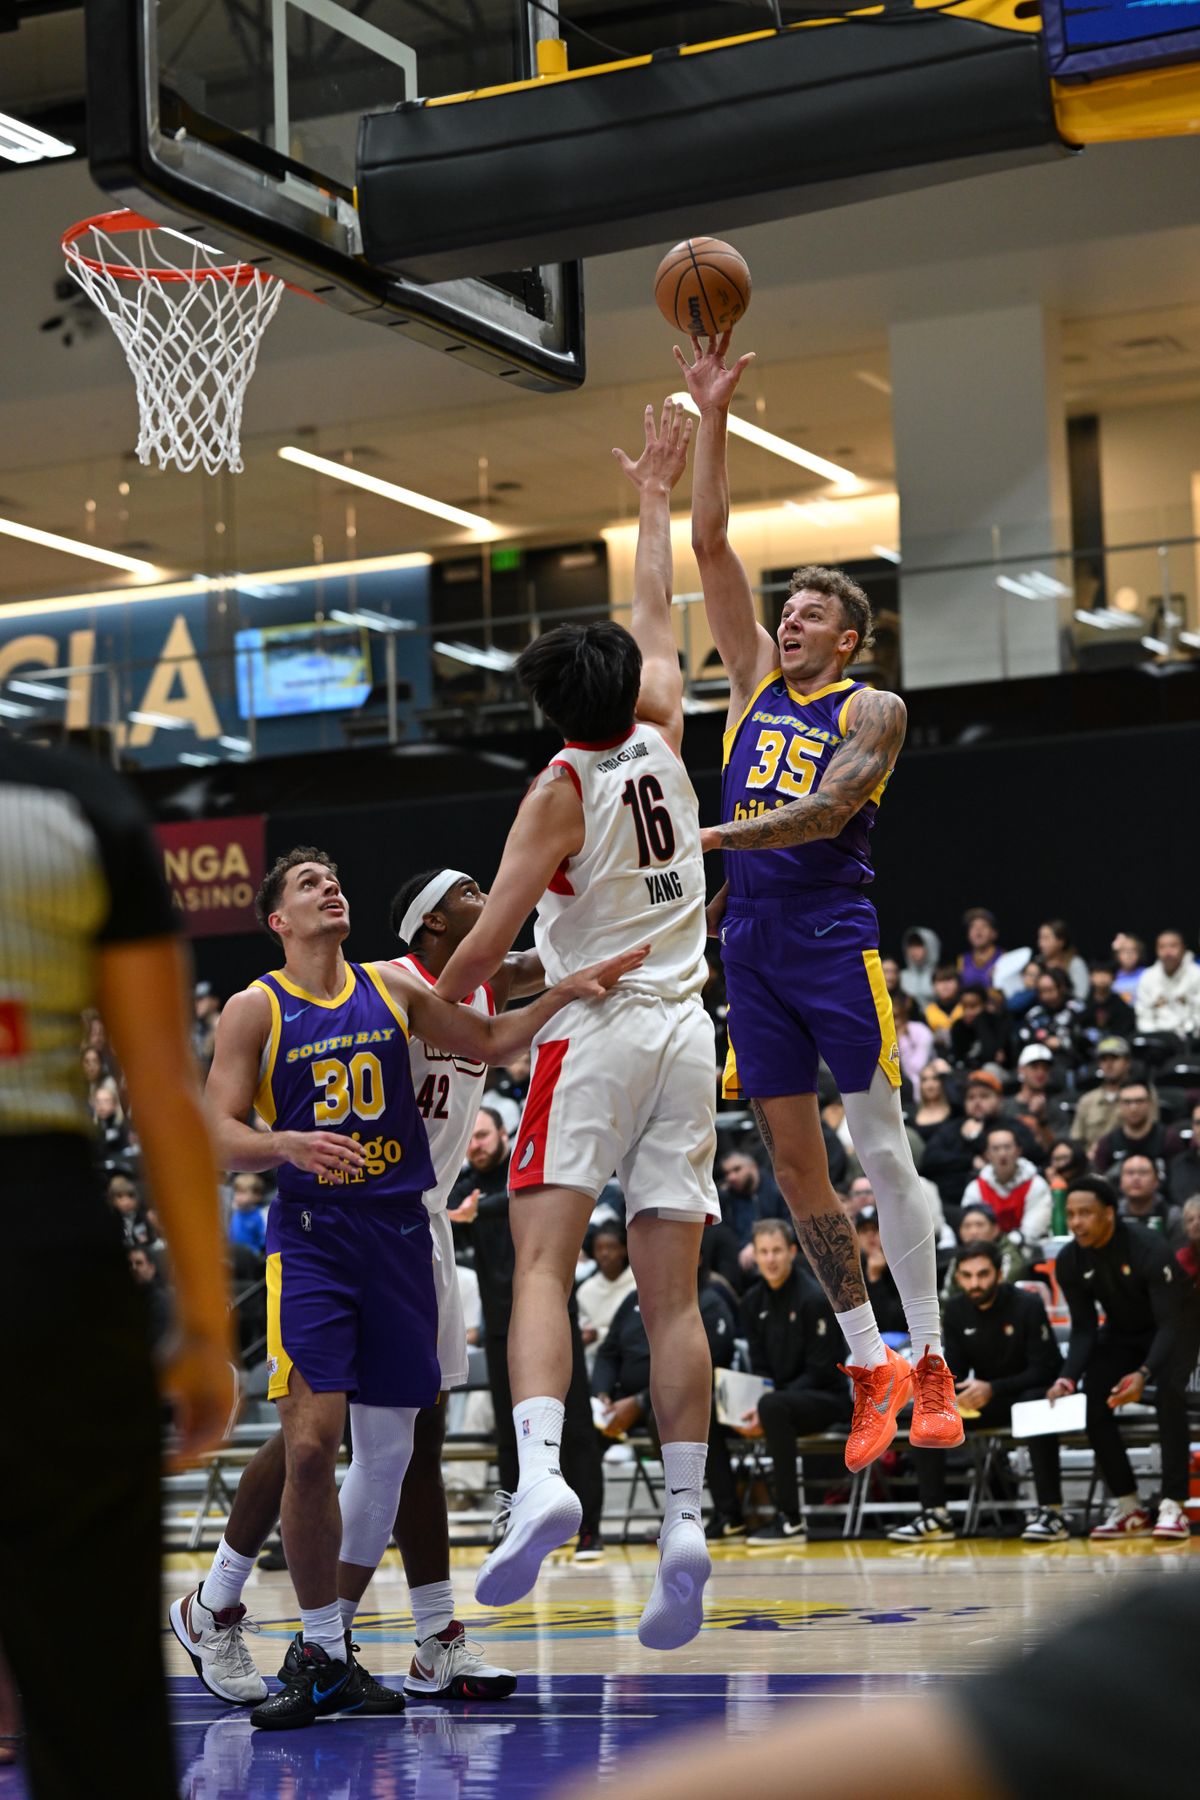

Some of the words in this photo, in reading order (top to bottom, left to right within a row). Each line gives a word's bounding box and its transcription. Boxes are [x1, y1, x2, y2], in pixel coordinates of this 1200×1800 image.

[752, 711, 806, 735] SOUTH
[806, 726, 841, 745] BAY
[745, 729, 825, 799] 35
[621, 774, 675, 868] 16
[645, 871, 684, 905] YANG
[286, 1034, 353, 1063] SOUTH
[354, 1028, 396, 1046] BAY
[311, 1051, 386, 1127] 30
[416, 1074, 450, 1119] 42
